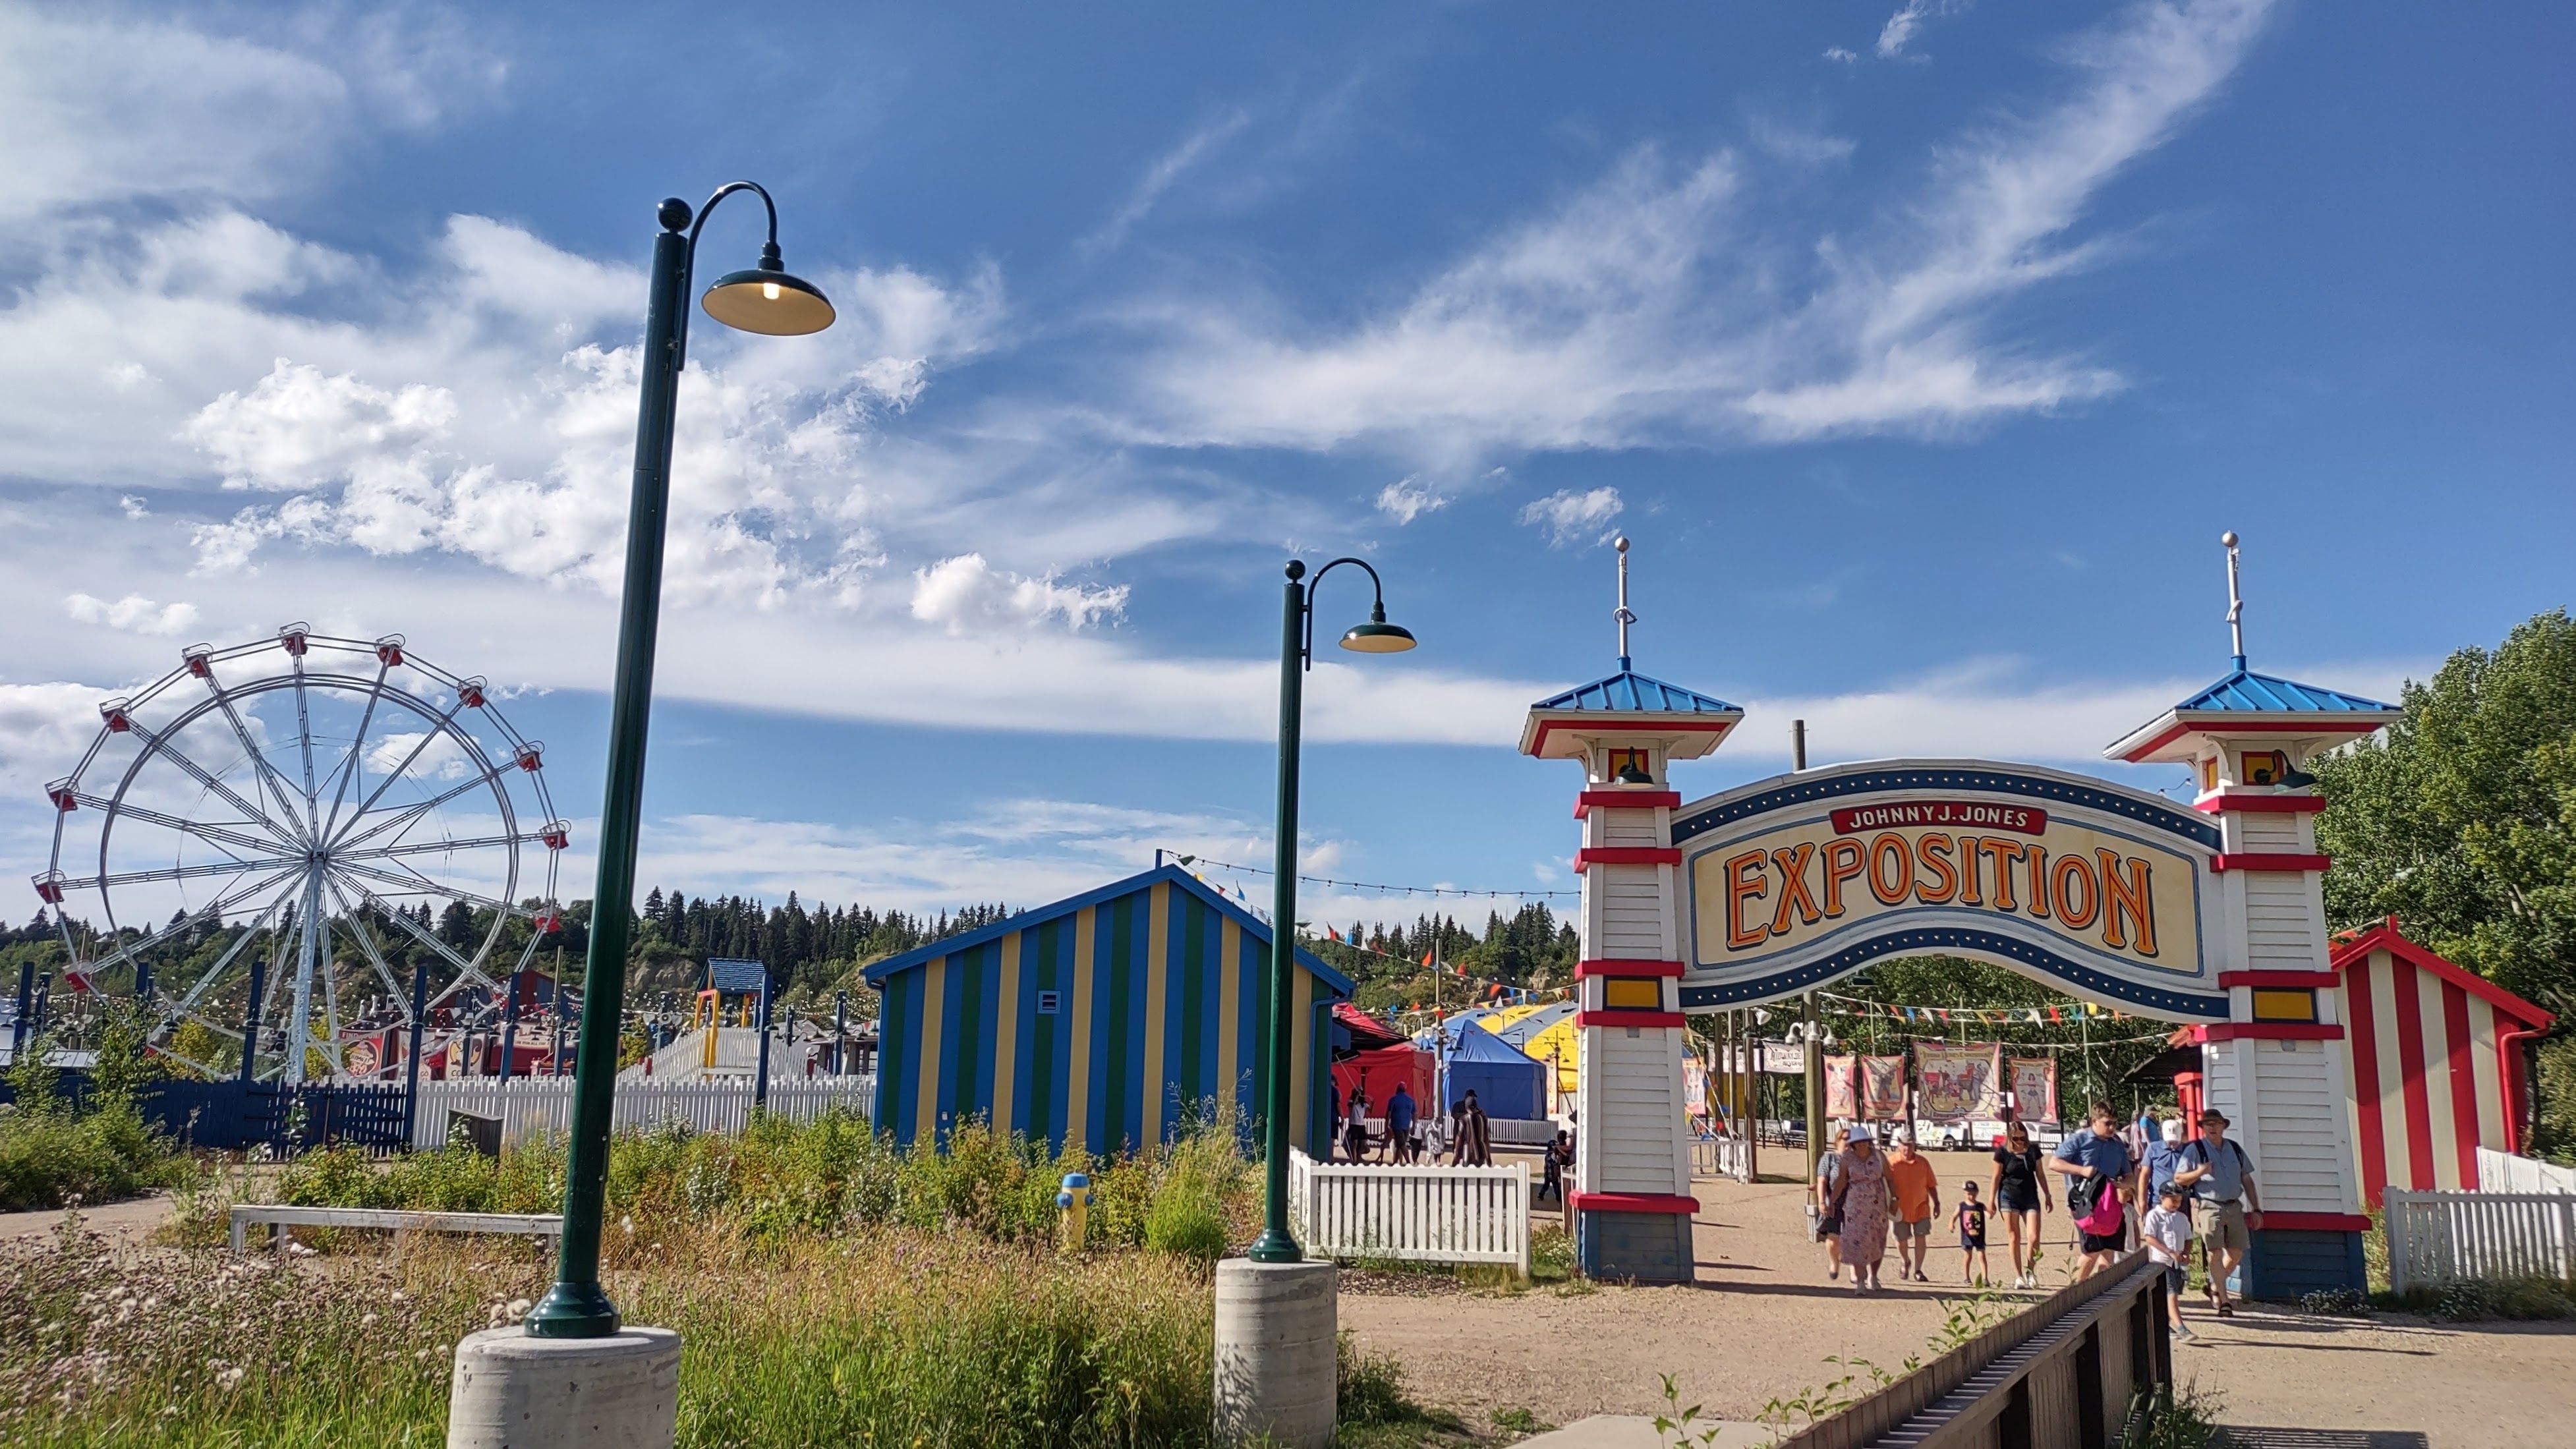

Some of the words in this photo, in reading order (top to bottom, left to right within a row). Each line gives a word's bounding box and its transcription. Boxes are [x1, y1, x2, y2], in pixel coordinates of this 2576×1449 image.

[1849, 805, 1935, 828] JOHNNY
[1938, 805, 1957, 822] J.
[1959, 805, 2028, 828] JONES
[1725, 831, 2159, 957] EXPOSITION
